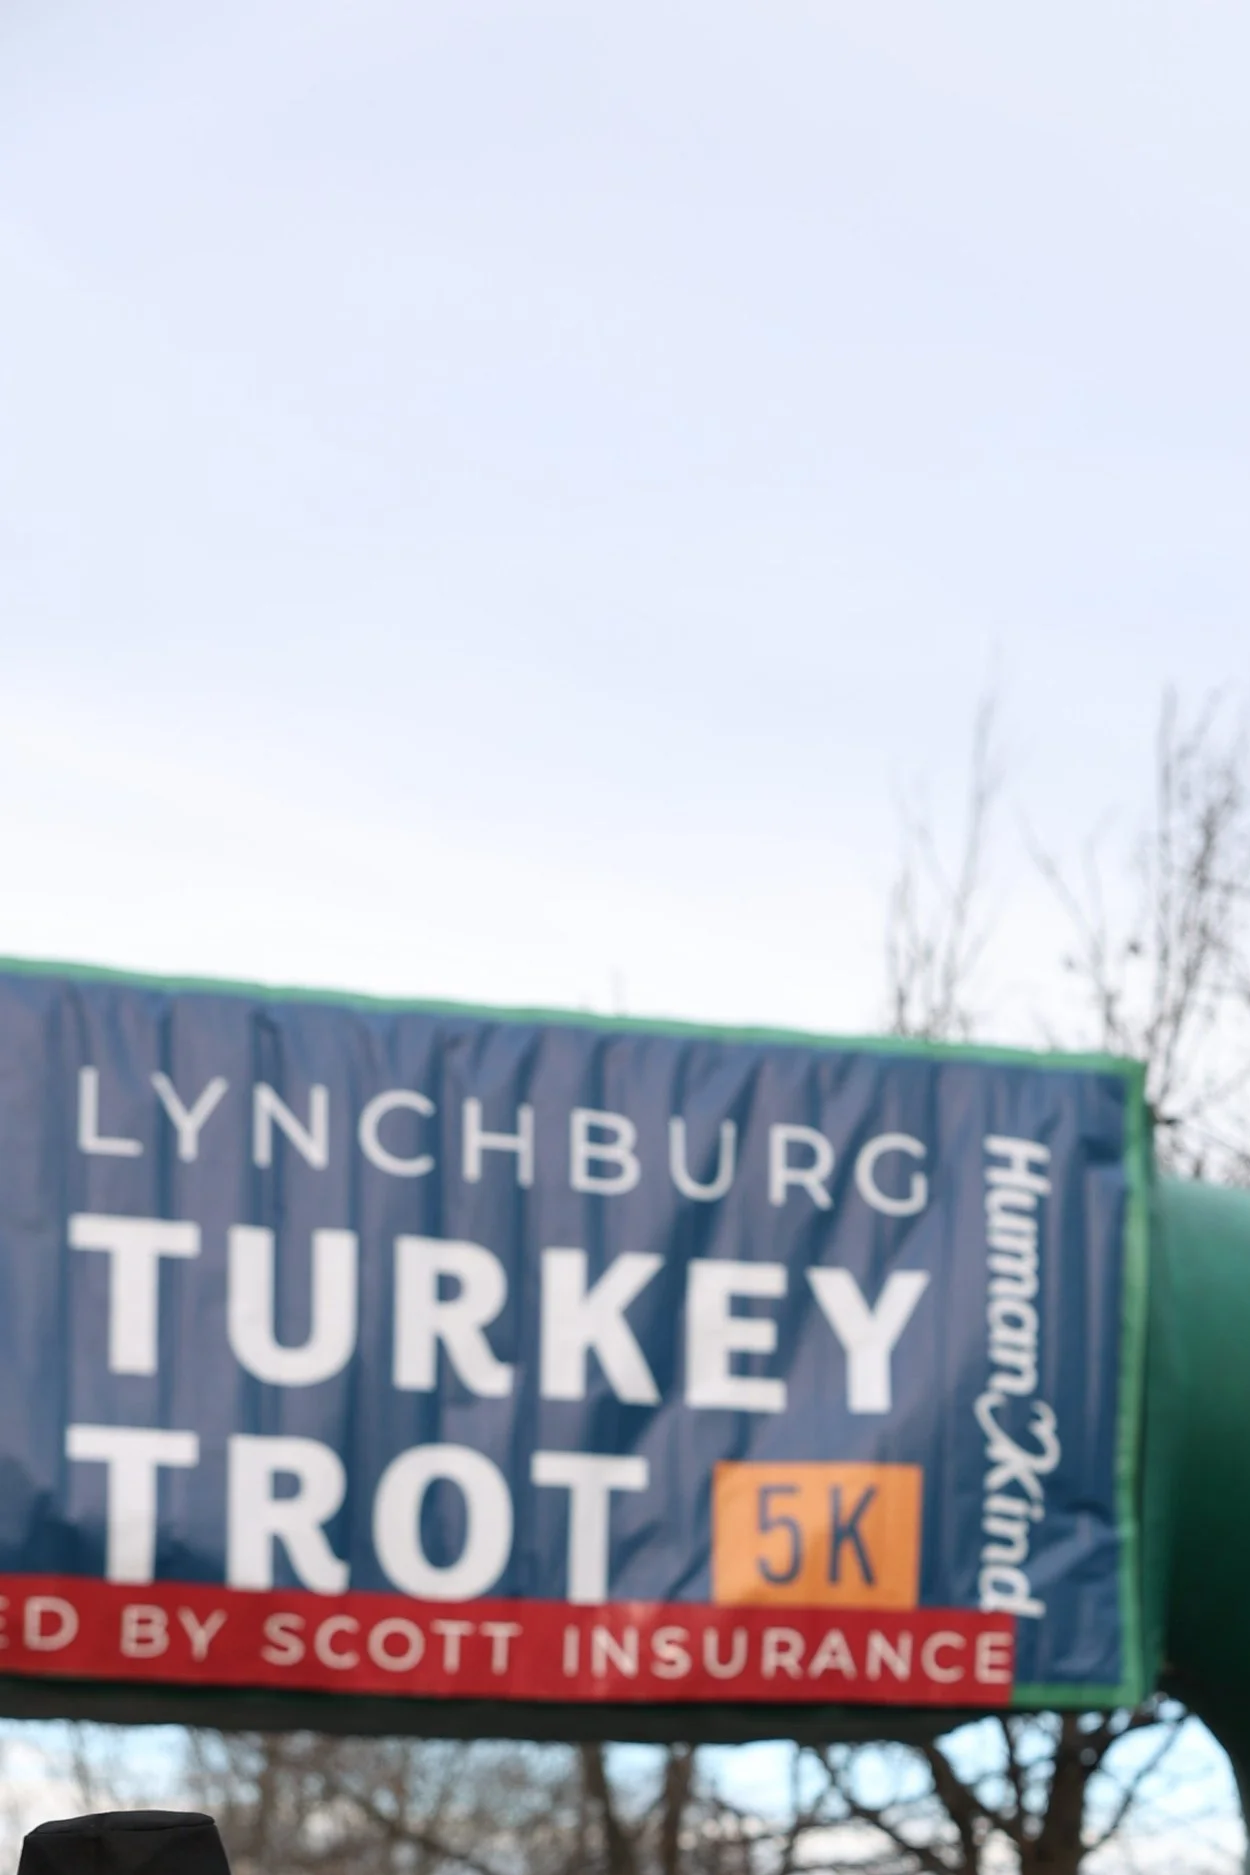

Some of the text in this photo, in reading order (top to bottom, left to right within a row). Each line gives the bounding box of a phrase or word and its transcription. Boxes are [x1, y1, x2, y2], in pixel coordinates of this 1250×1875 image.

[76, 1065, 929, 1218] LYNCHBURG
[66, 1212, 931, 1415] TURKEY
[65, 1422, 878, 1606] TROT 5K
[0, 1593, 1013, 1685] D BY SCOTT INSURANCE
